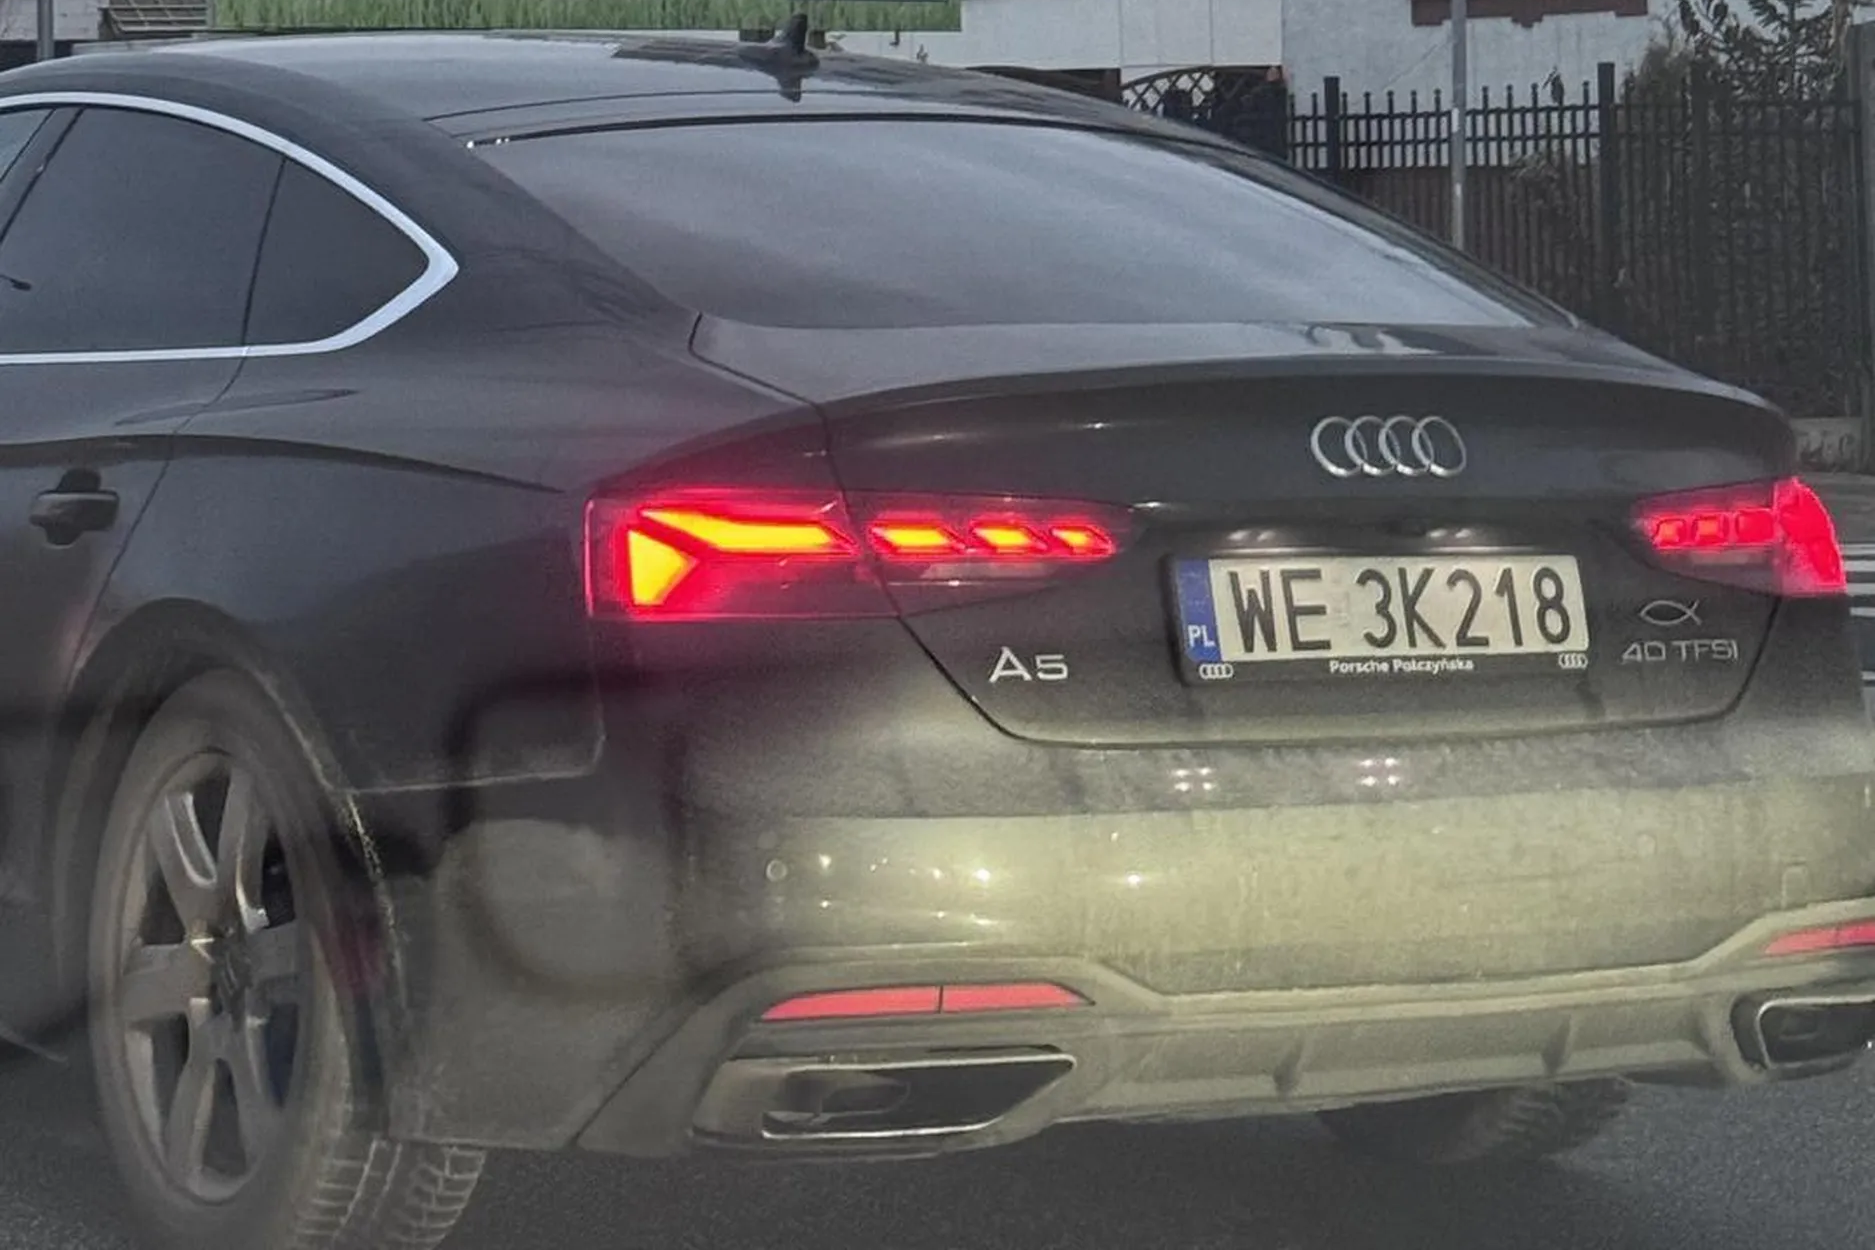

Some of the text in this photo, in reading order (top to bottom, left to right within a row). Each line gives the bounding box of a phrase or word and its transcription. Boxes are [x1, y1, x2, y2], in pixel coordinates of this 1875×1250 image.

[1229, 566, 1572, 654] WE 3K218
[1187, 624, 1216, 649] PL
[1621, 637, 1740, 664] 40 TFSI
[988, 645, 1070, 684] A5
[1329, 659, 1390, 674] Porsche
